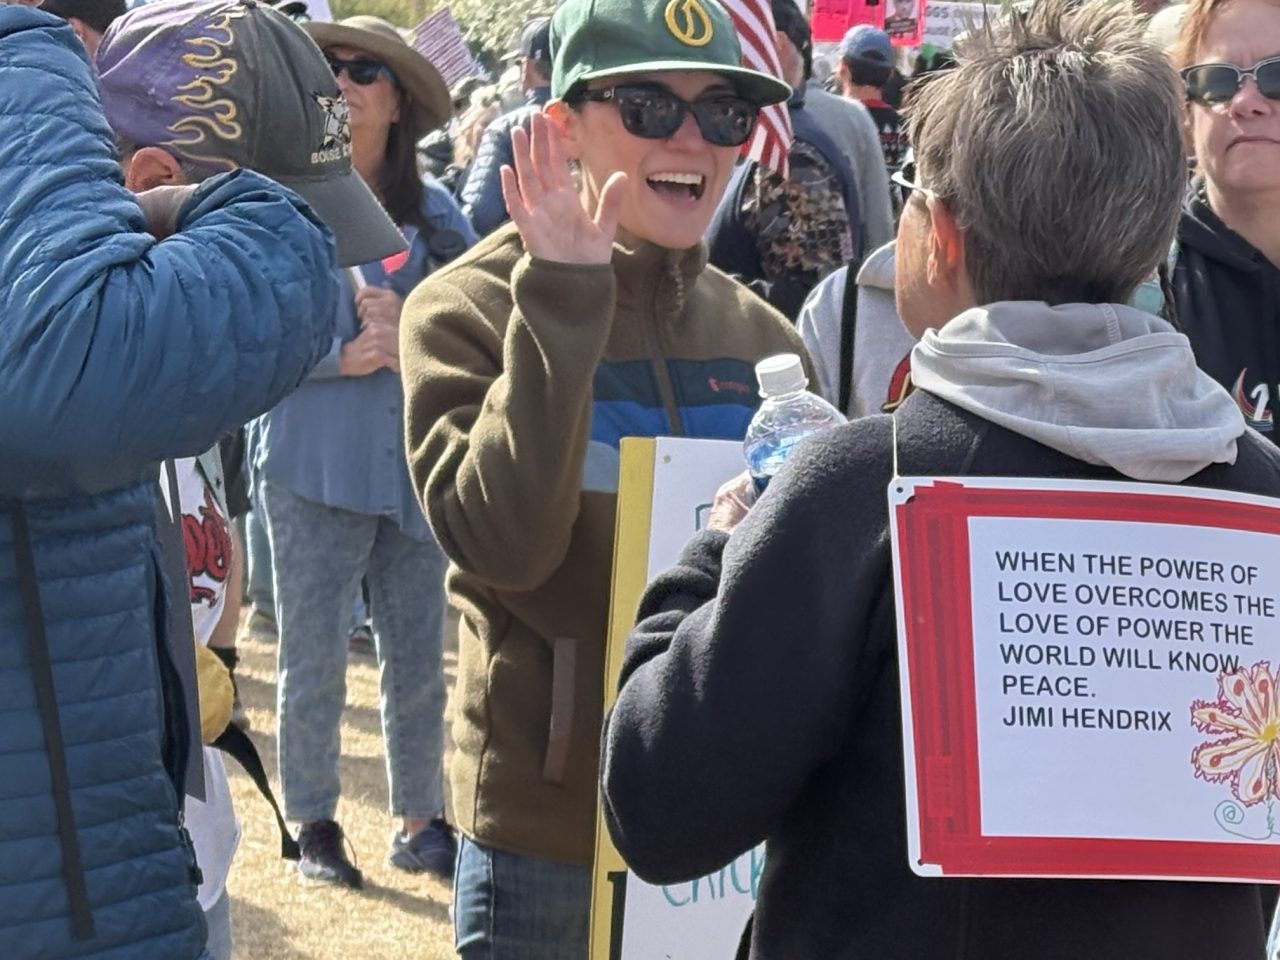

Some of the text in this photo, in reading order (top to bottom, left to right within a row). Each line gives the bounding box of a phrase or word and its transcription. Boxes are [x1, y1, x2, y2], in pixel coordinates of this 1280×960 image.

[995, 551, 1259, 585] WHEN THE POWER OF
[998, 581, 1275, 618] LOVE OVERCOMES THE
[999, 612, 1254, 646] LOVE OF POWER THE
[999, 643, 1239, 675] WORLD WILL KNOW
[1002, 674, 1096, 698] PEACE.
[1003, 706, 1172, 732] JIMI HENDRIX
